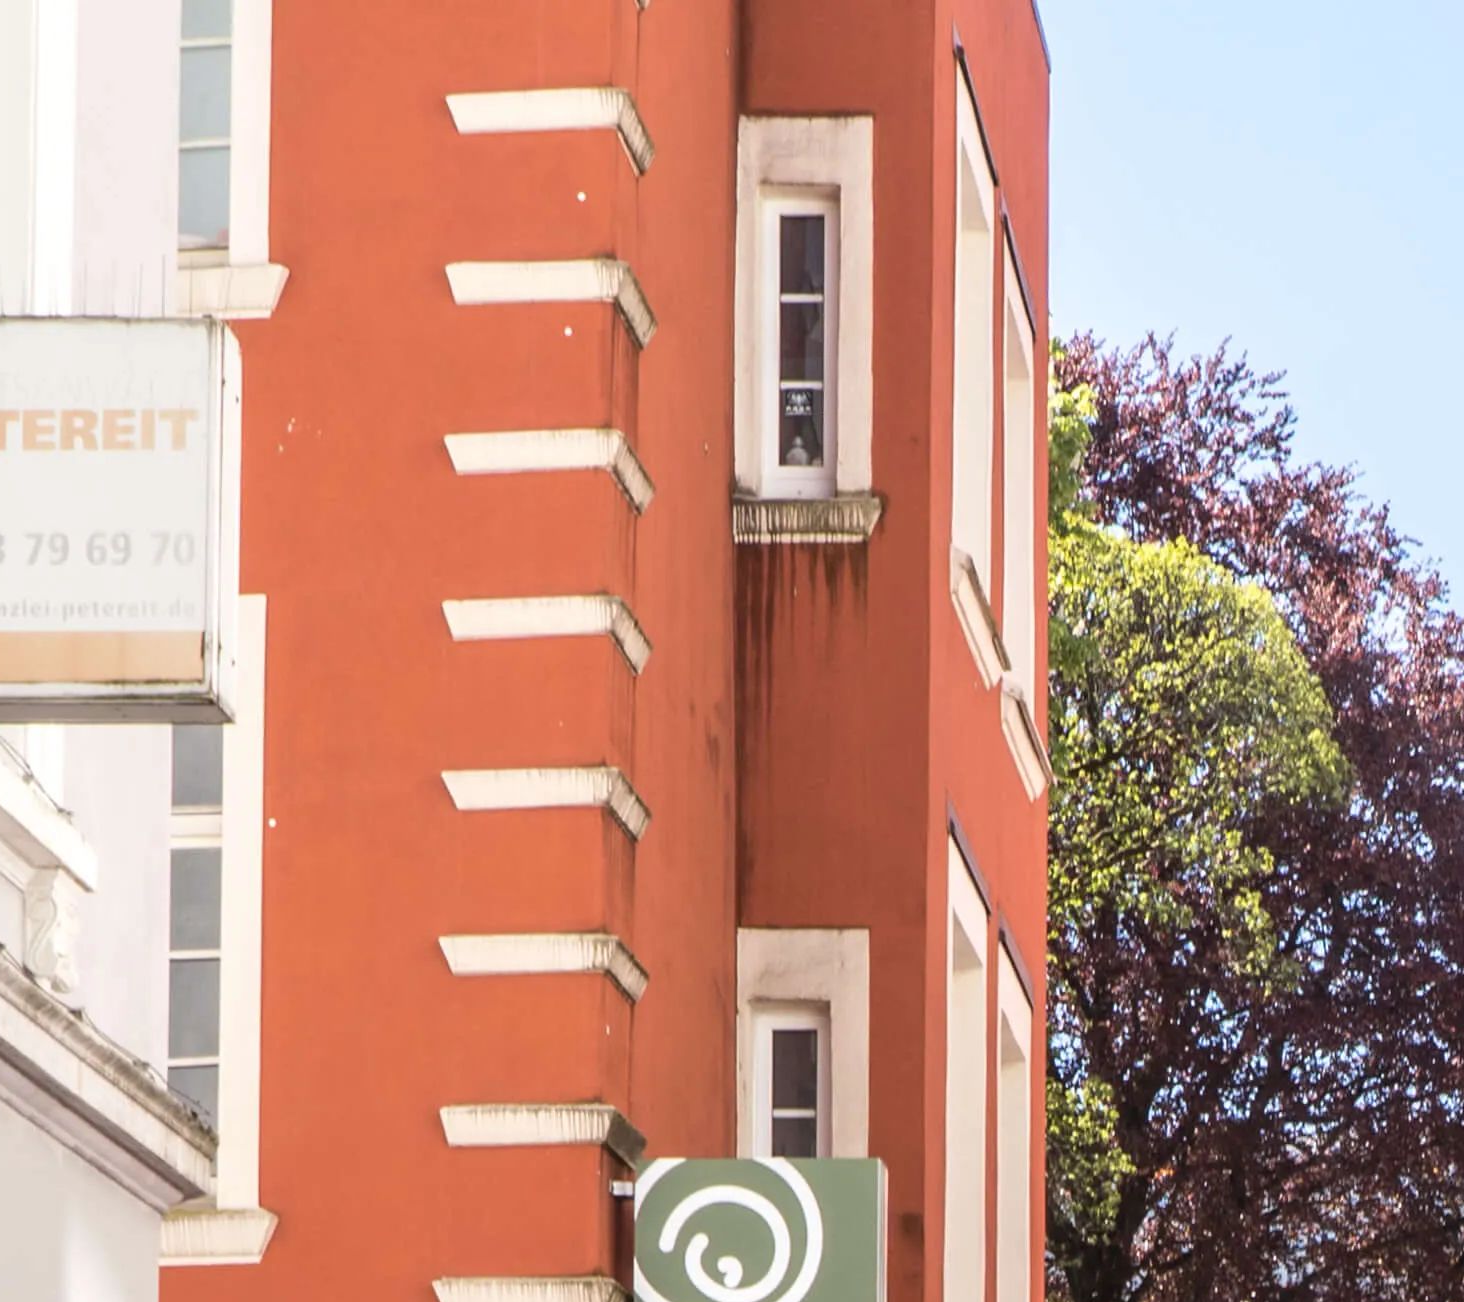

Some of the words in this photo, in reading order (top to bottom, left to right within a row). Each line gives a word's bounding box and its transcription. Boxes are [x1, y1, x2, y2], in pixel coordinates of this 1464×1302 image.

[25, 533, 69, 567] 79
[86, 533, 132, 567] 69
[151, 533, 196, 567] 70
